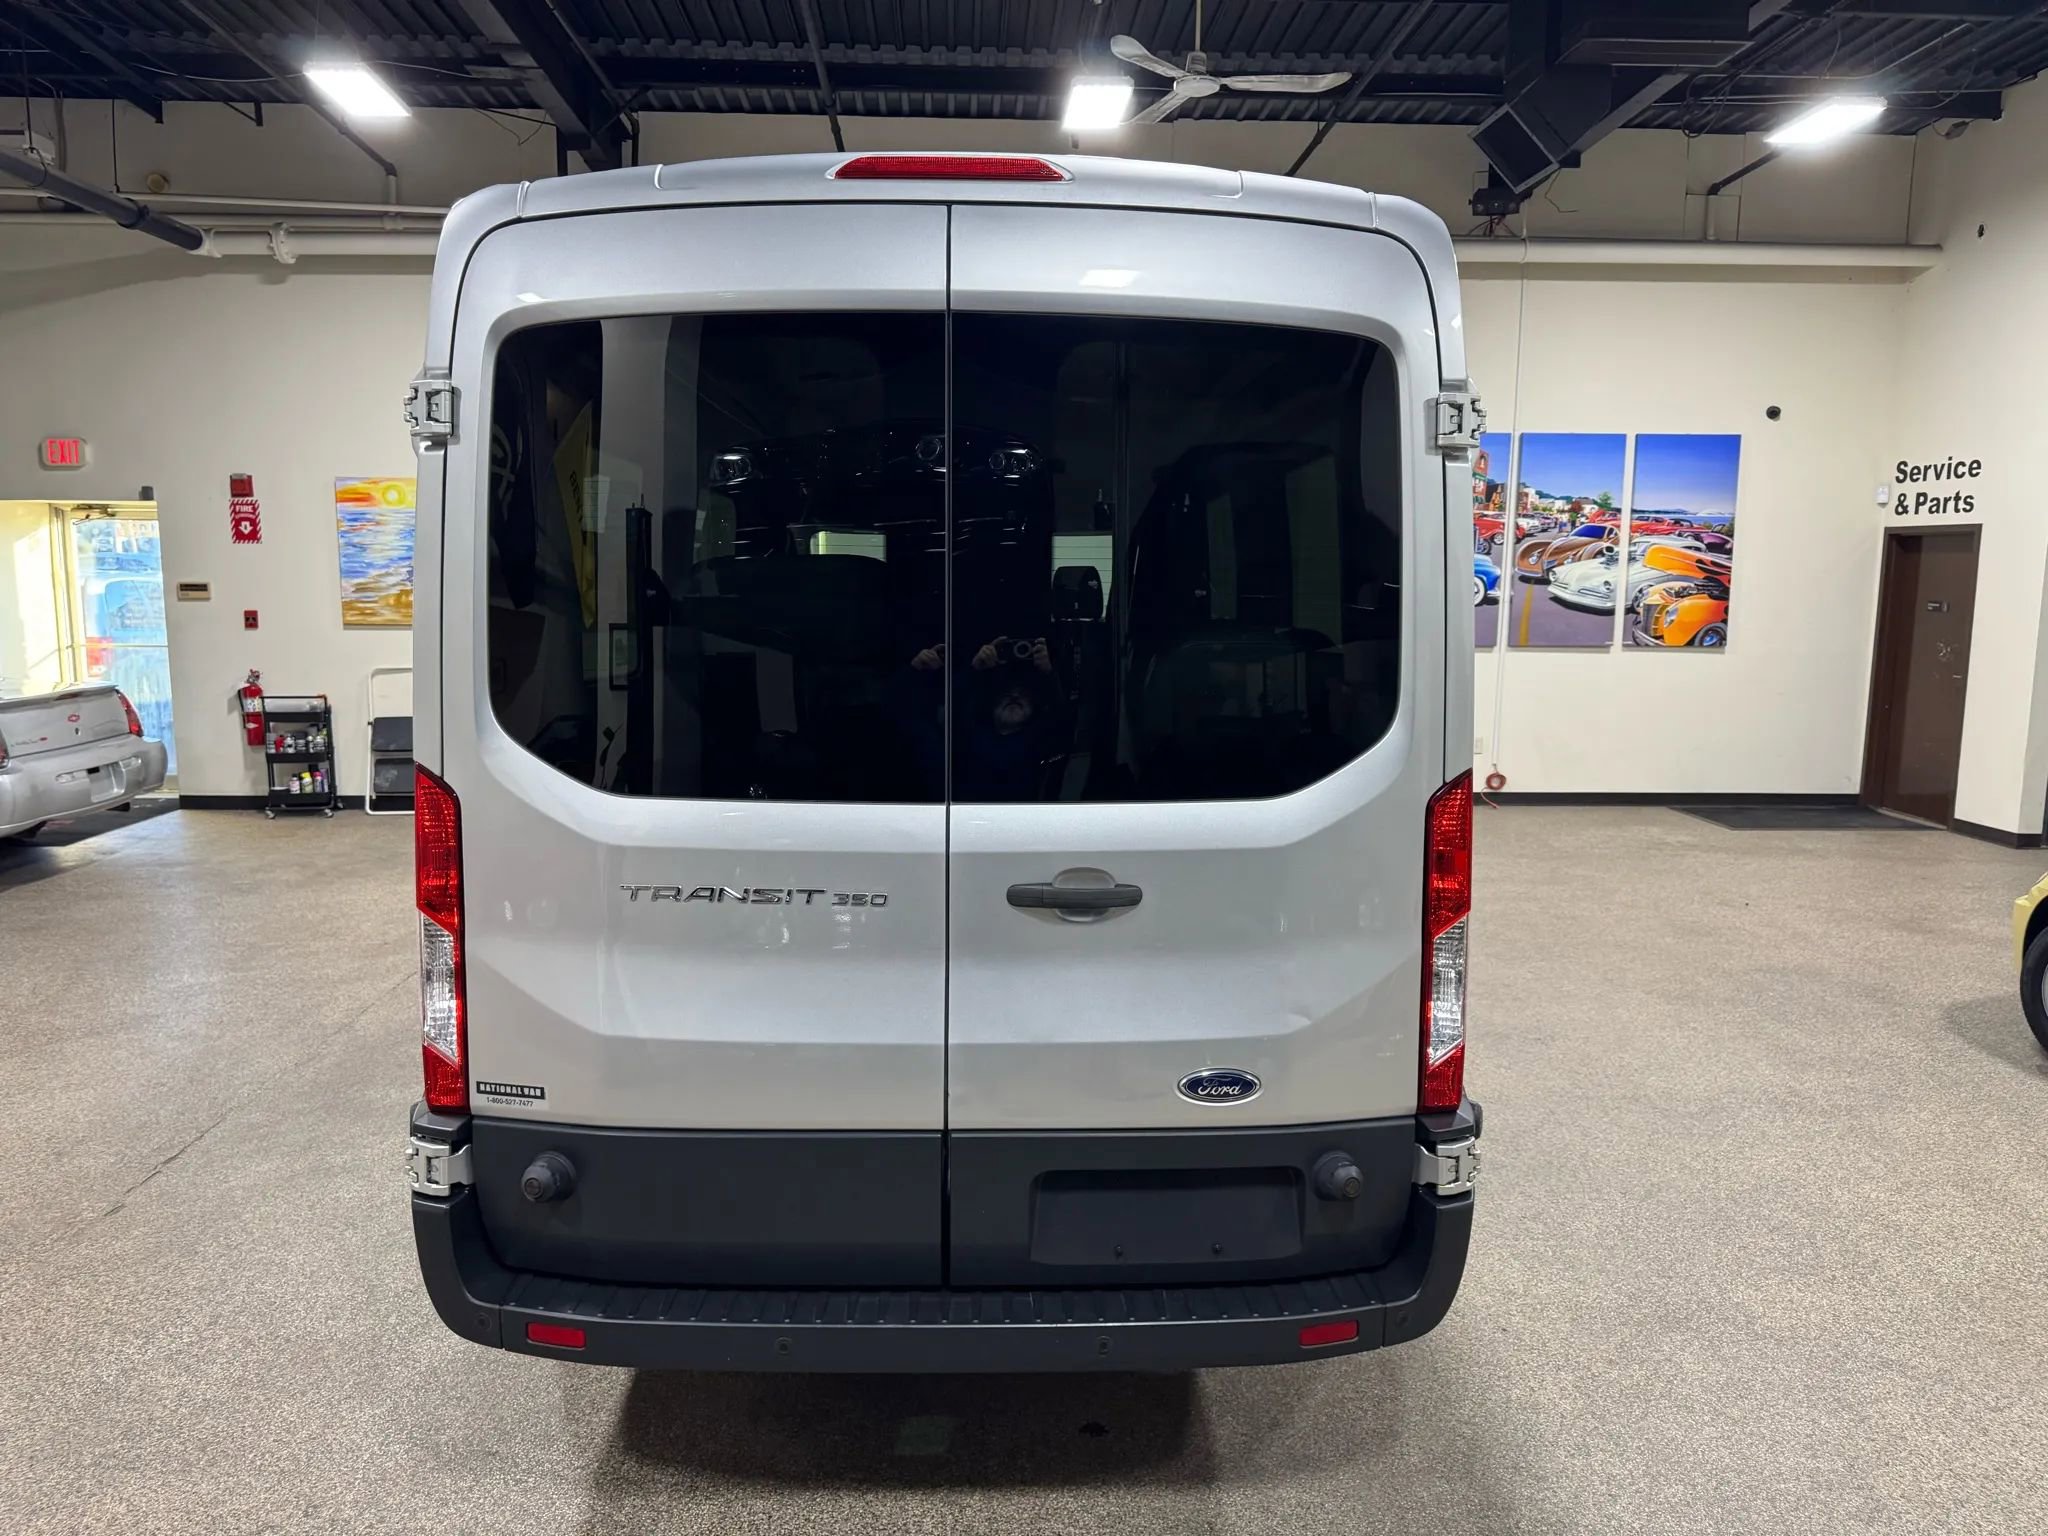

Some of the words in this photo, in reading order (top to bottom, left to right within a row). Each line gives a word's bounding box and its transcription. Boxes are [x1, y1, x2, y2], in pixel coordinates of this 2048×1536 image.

[48, 439, 80, 465] EXIT
[1895, 456, 1982, 484] Service
[235, 505, 254, 513] FIRE
[1894, 493, 1910, 516] &
[1914, 490, 1975, 515] Parts
[620, 885, 827, 905] TRANSIT
[832, 893, 888, 906] 350
[480, 1083, 522, 1095] NATIONAL
[523, 1087, 542, 1097] VAN
[1197, 1077, 1243, 1096] Ford
[486, 1097, 534, 1107] 1-800-527-7477
